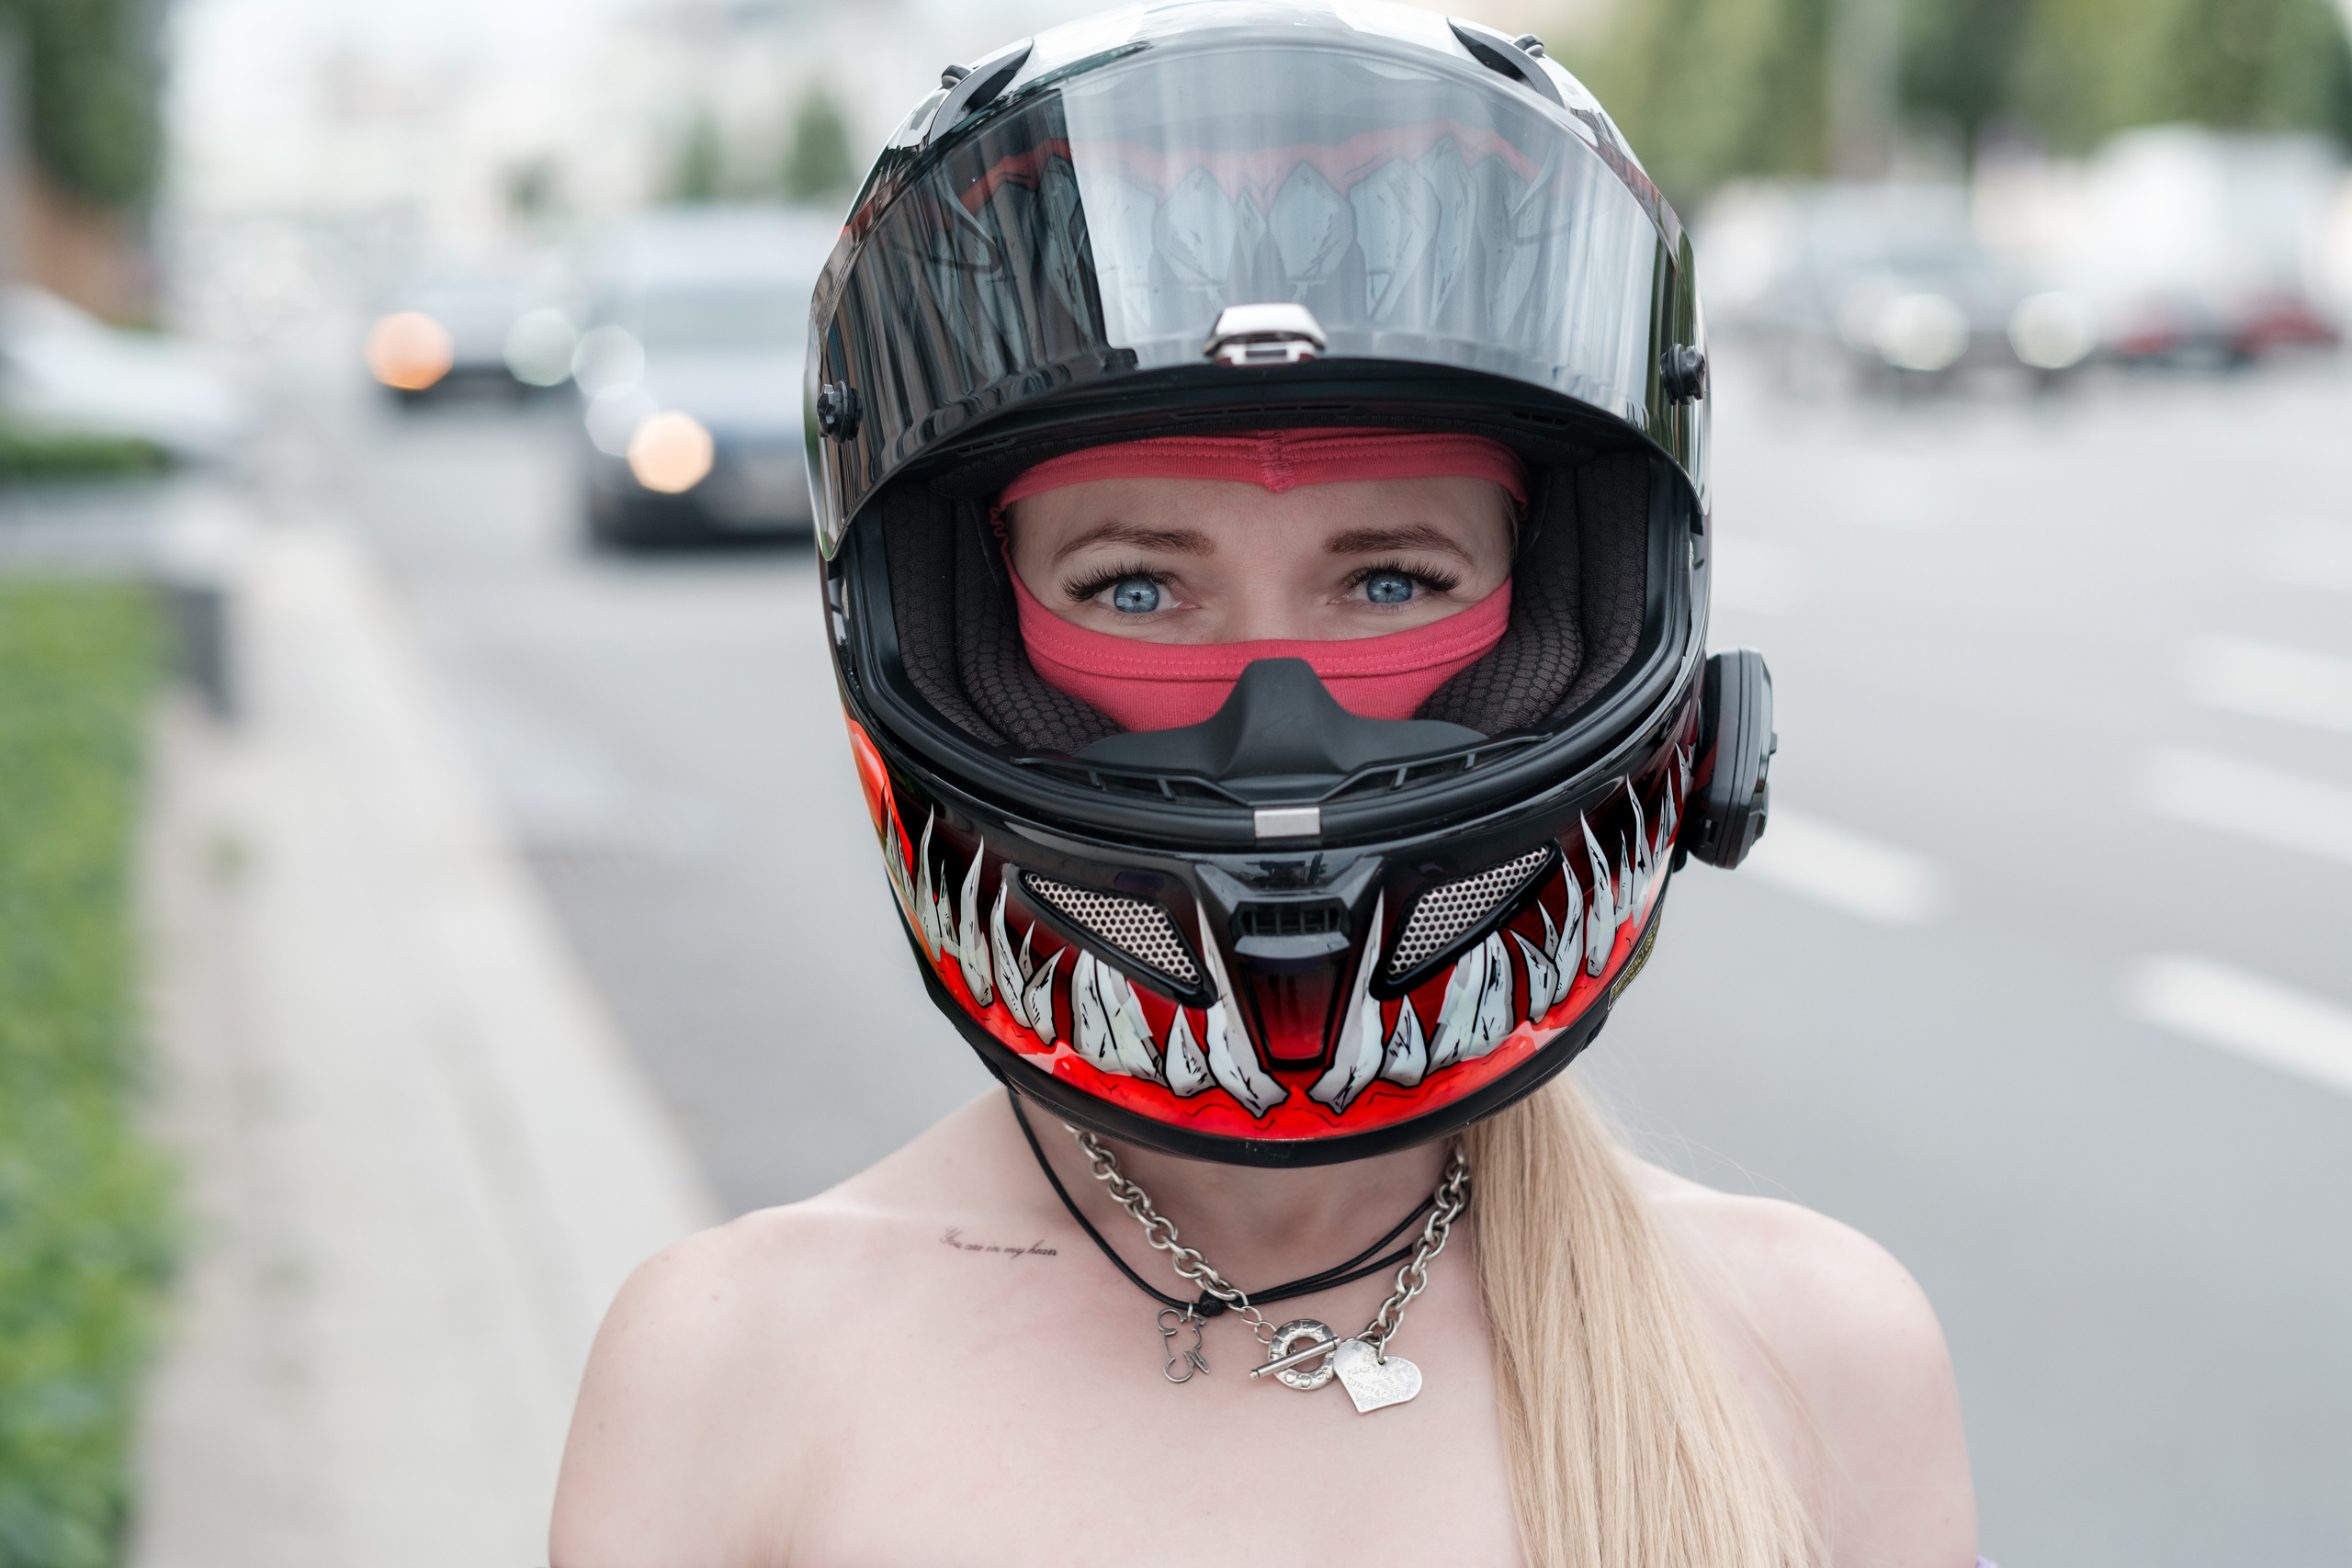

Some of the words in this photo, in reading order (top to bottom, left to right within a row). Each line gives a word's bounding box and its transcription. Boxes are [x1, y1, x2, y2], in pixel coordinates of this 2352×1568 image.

[1610, 947, 1645, 998] EMERGENCY
[965, 1243, 983, 1251] are
[985, 1242, 1001, 1253] in
[1003, 1246, 1025, 1259] my
[1268, 1319, 1335, 1361] TIFFA
[1346, 1366, 1371, 1375] PLEASE
[1374, 1368, 1395, 1385] RETURN
[1393, 1386, 1401, 1396] TO
[1346, 1376, 1374, 1393] TIFFANY
